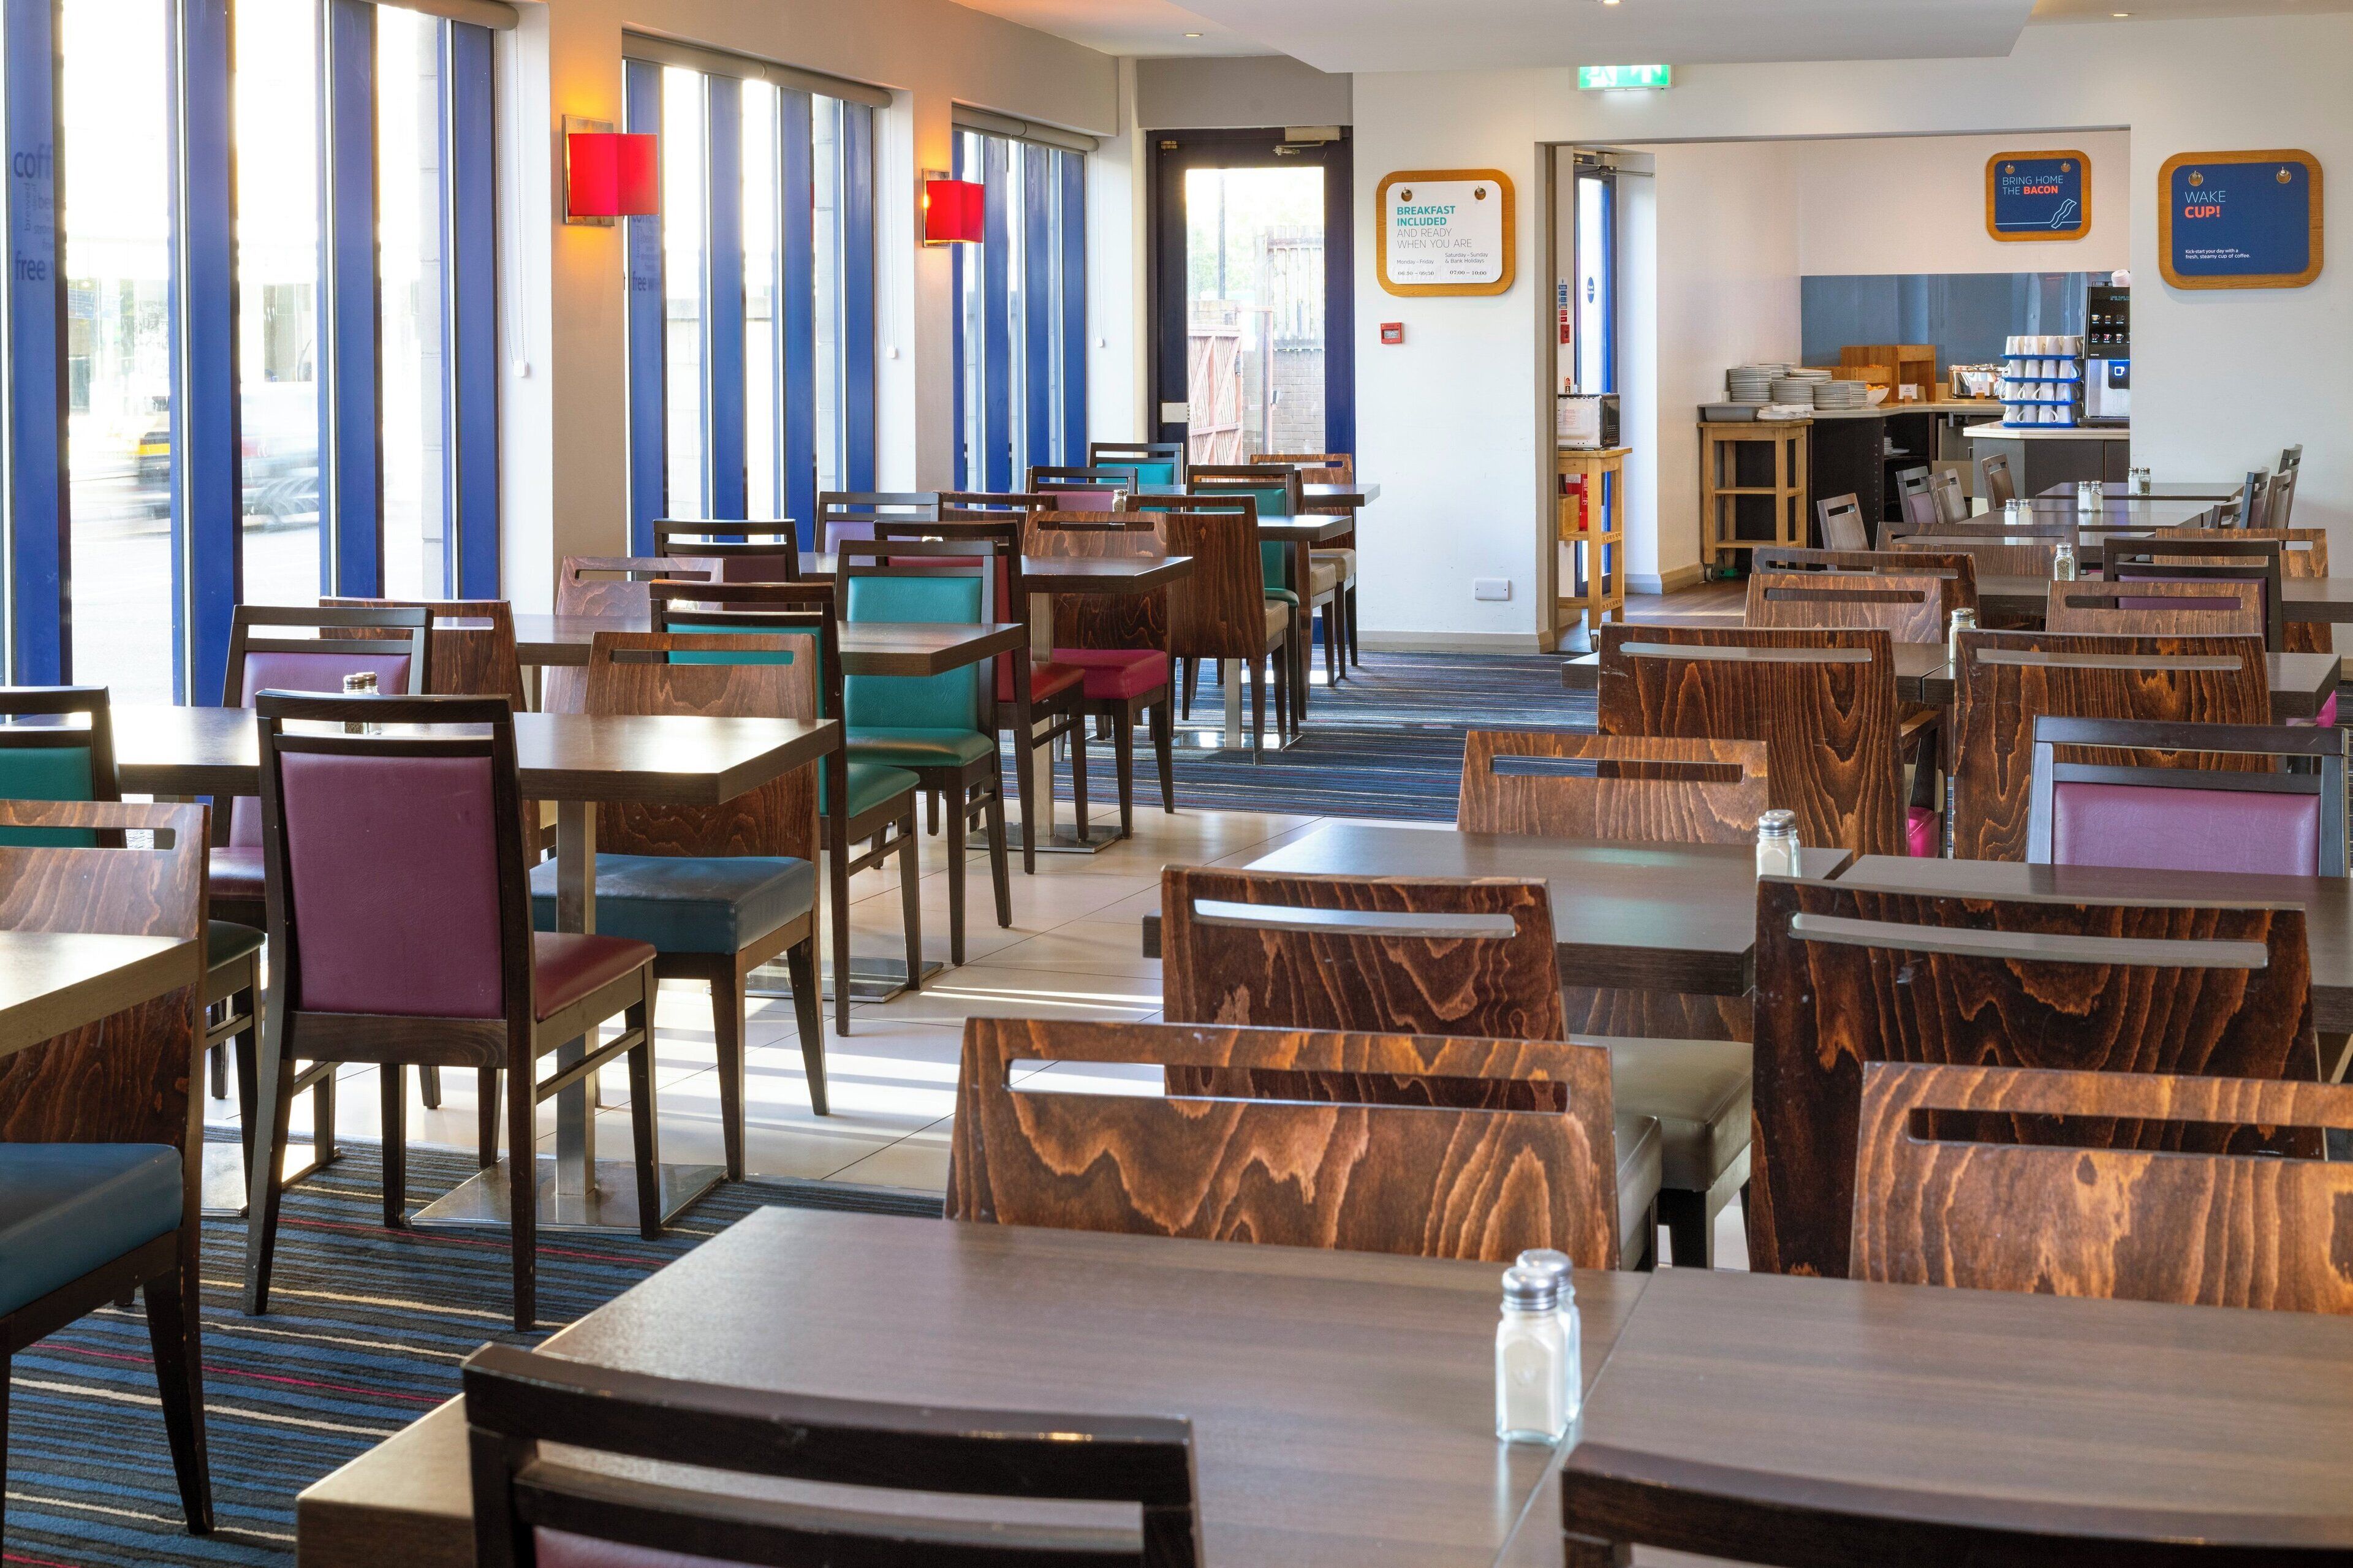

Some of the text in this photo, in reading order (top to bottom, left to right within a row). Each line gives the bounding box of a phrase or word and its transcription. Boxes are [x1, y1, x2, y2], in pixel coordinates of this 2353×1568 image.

[2003, 175, 2063, 185] BRING HOME
[2003, 185, 2058, 195] THE BACON
[2184, 191, 2226, 203] WAKE
[1397, 205, 1455, 215] BREAKFAST
[2184, 205, 2220, 218] CUP!
[1397, 217, 1447, 226] INCLUDED
[1397, 228, 1452, 237] AND READY
[1397, 238, 1472, 249] WHEN YOU ARE
[15, 250, 47, 281] free
